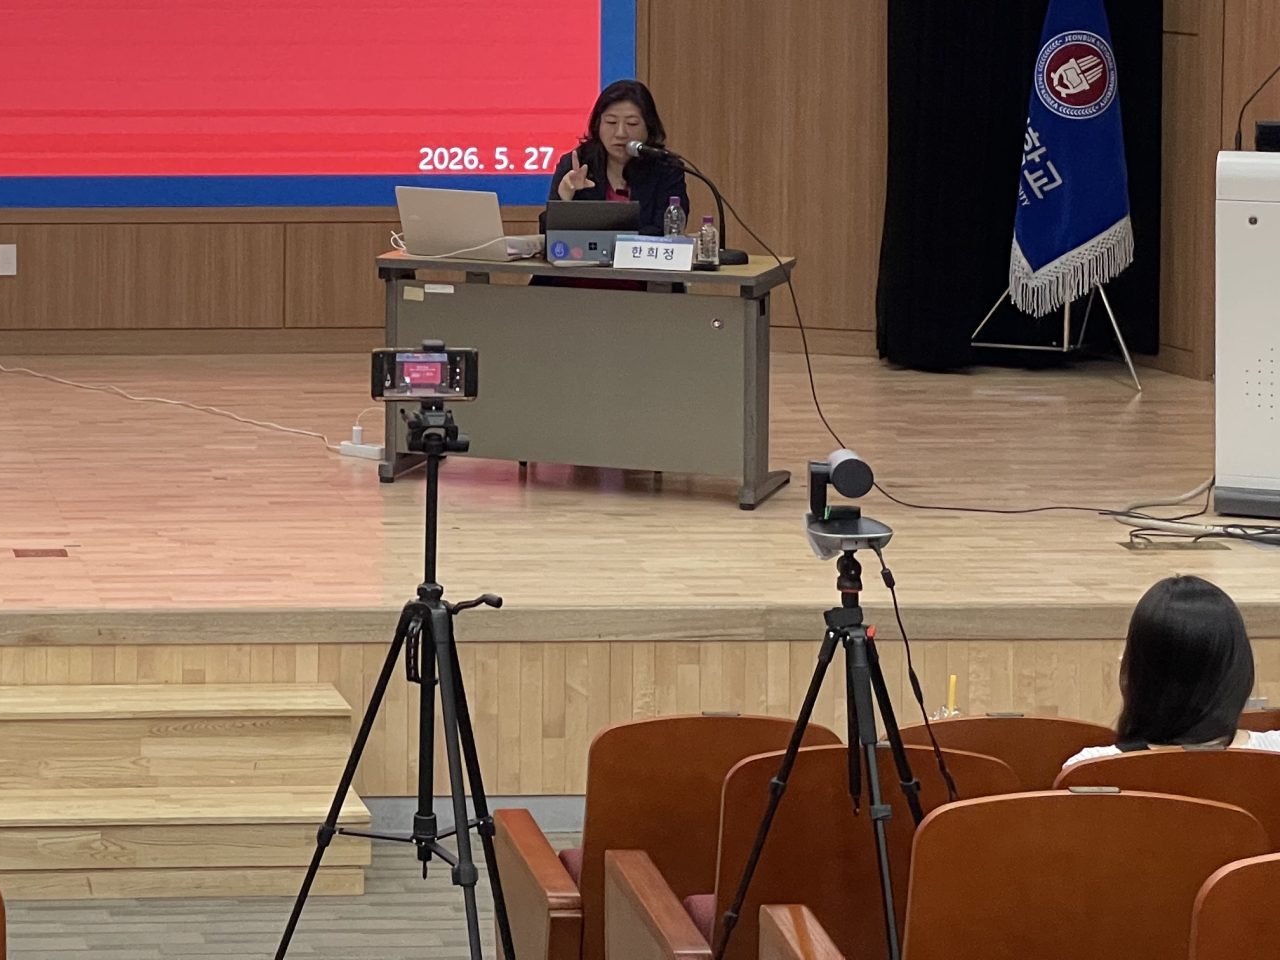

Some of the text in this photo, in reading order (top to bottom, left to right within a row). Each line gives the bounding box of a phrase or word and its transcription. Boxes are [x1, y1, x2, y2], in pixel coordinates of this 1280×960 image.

[419, 147, 553, 170] 2026. 5. 27
[631, 246, 675, 261] 한희정
